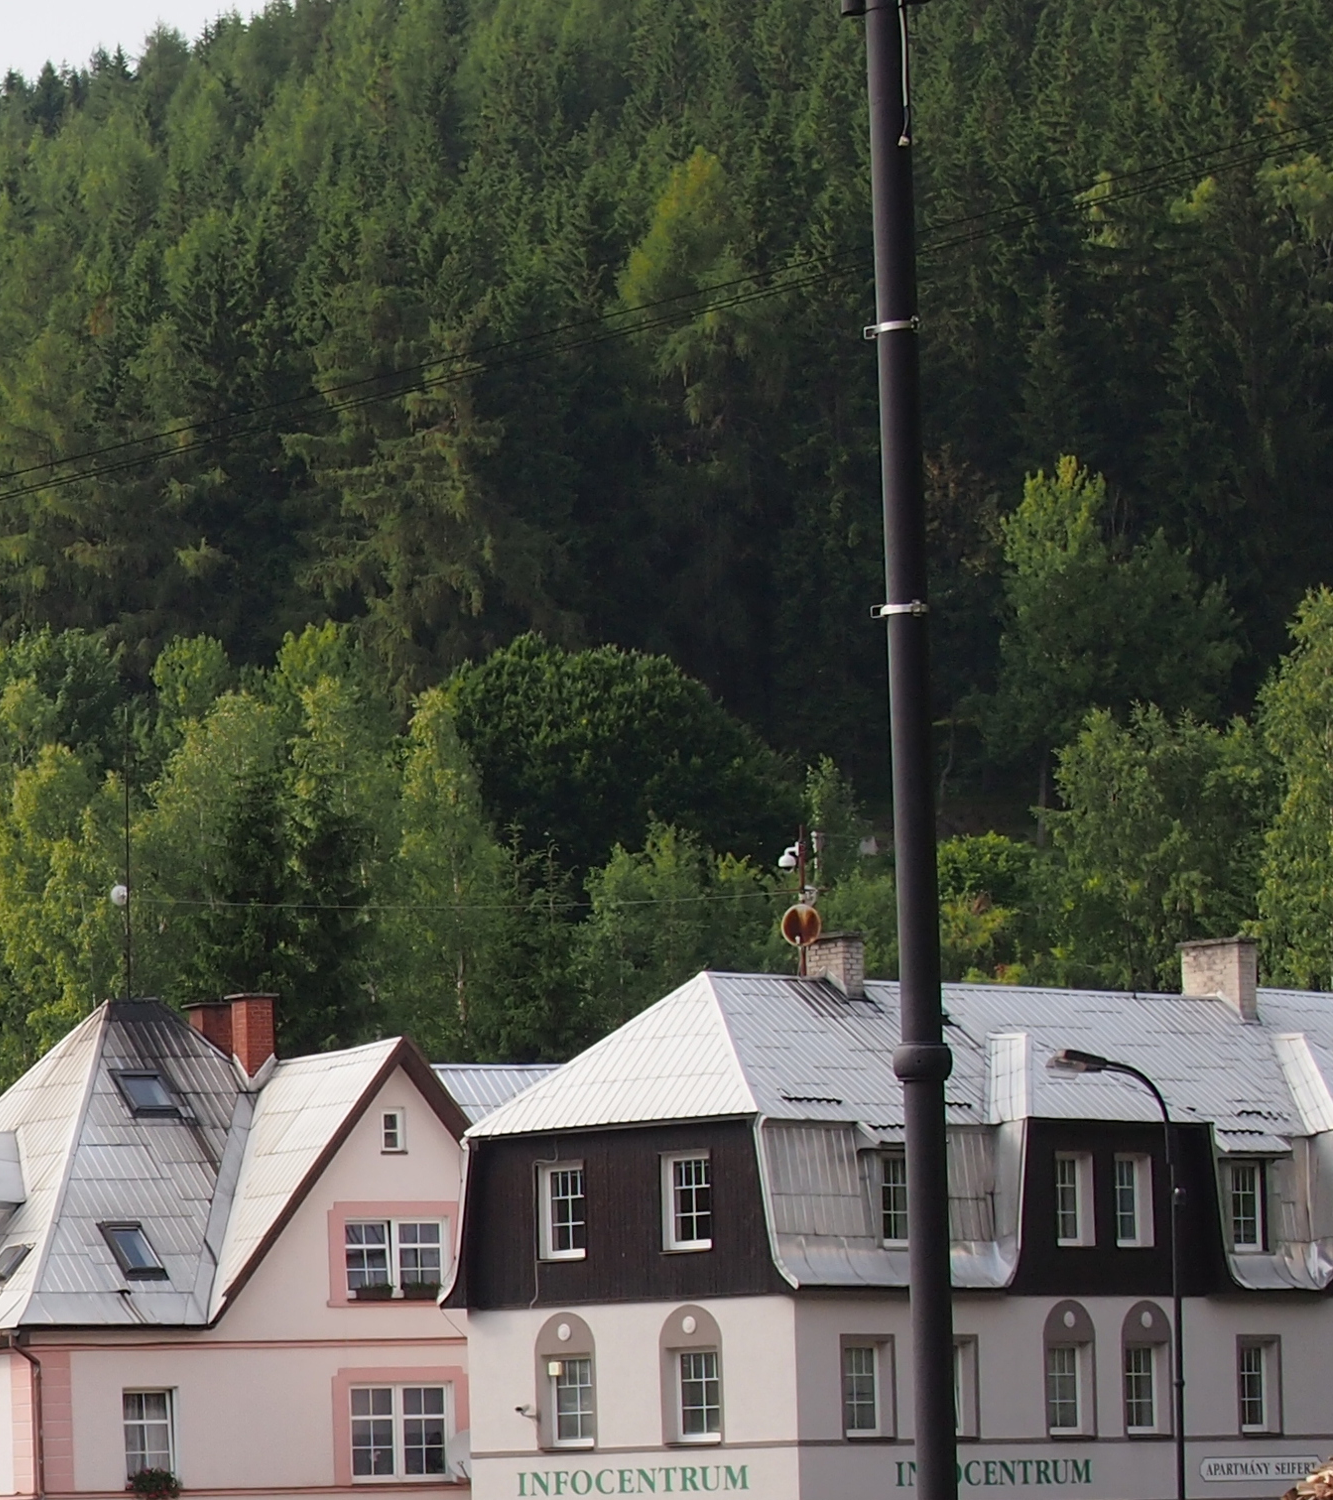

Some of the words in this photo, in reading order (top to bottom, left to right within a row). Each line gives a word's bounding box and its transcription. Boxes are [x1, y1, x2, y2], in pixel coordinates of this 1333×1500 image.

[517, 1464, 750, 1497] INFOCENTRUM
[895, 1458, 1092, 1487] INCENTRUM
[1206, 1460, 1270, 1476] APARTMÁNY
